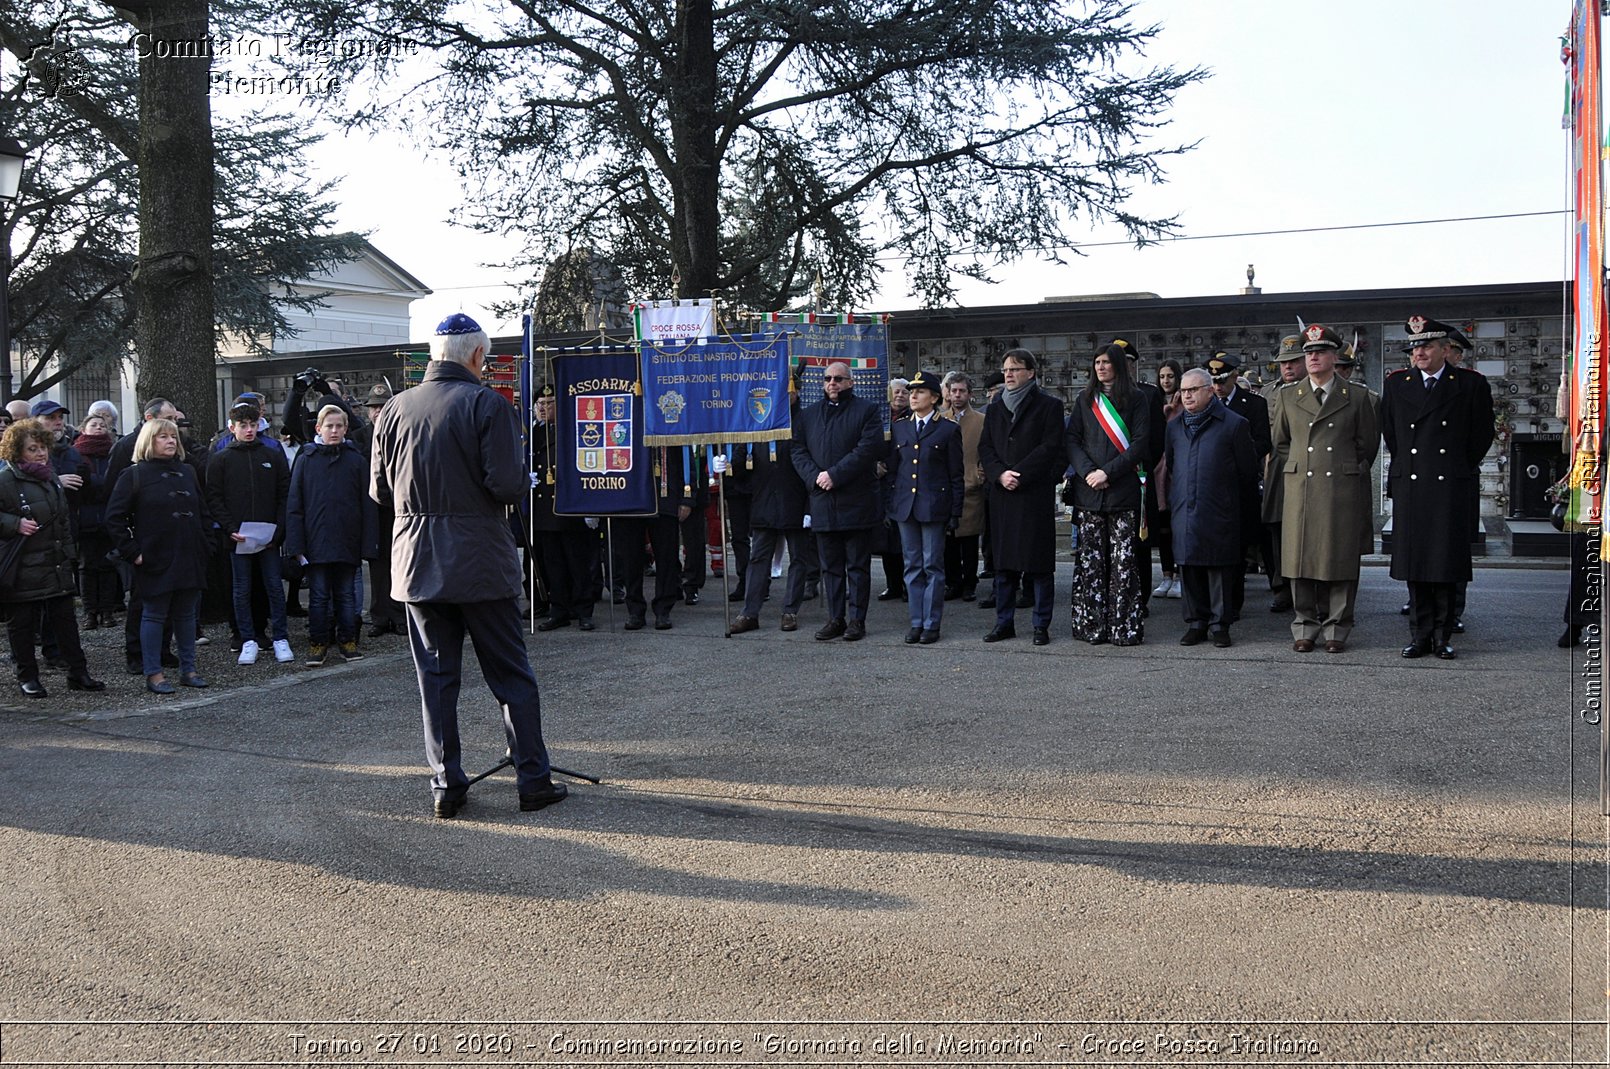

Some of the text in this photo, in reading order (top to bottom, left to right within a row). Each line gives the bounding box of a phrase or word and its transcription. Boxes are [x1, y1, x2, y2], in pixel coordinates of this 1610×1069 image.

[650, 323, 701, 333] CROCE ROSSA
[805, 340, 846, 350] PIEMONTE
[652, 349, 778, 364] ISTITUTO DEL NASTRO AZZURRO
[656, 371, 778, 385] FEDERAZIONE PROVINCIALE
[568, 378, 637, 397] ASSOARMA
[711, 389, 721, 398] DI
[700, 399, 734, 409] TORINO
[1533, 433, 1563, 441] MIGLIO
[580, 476, 627, 490] TORINO
